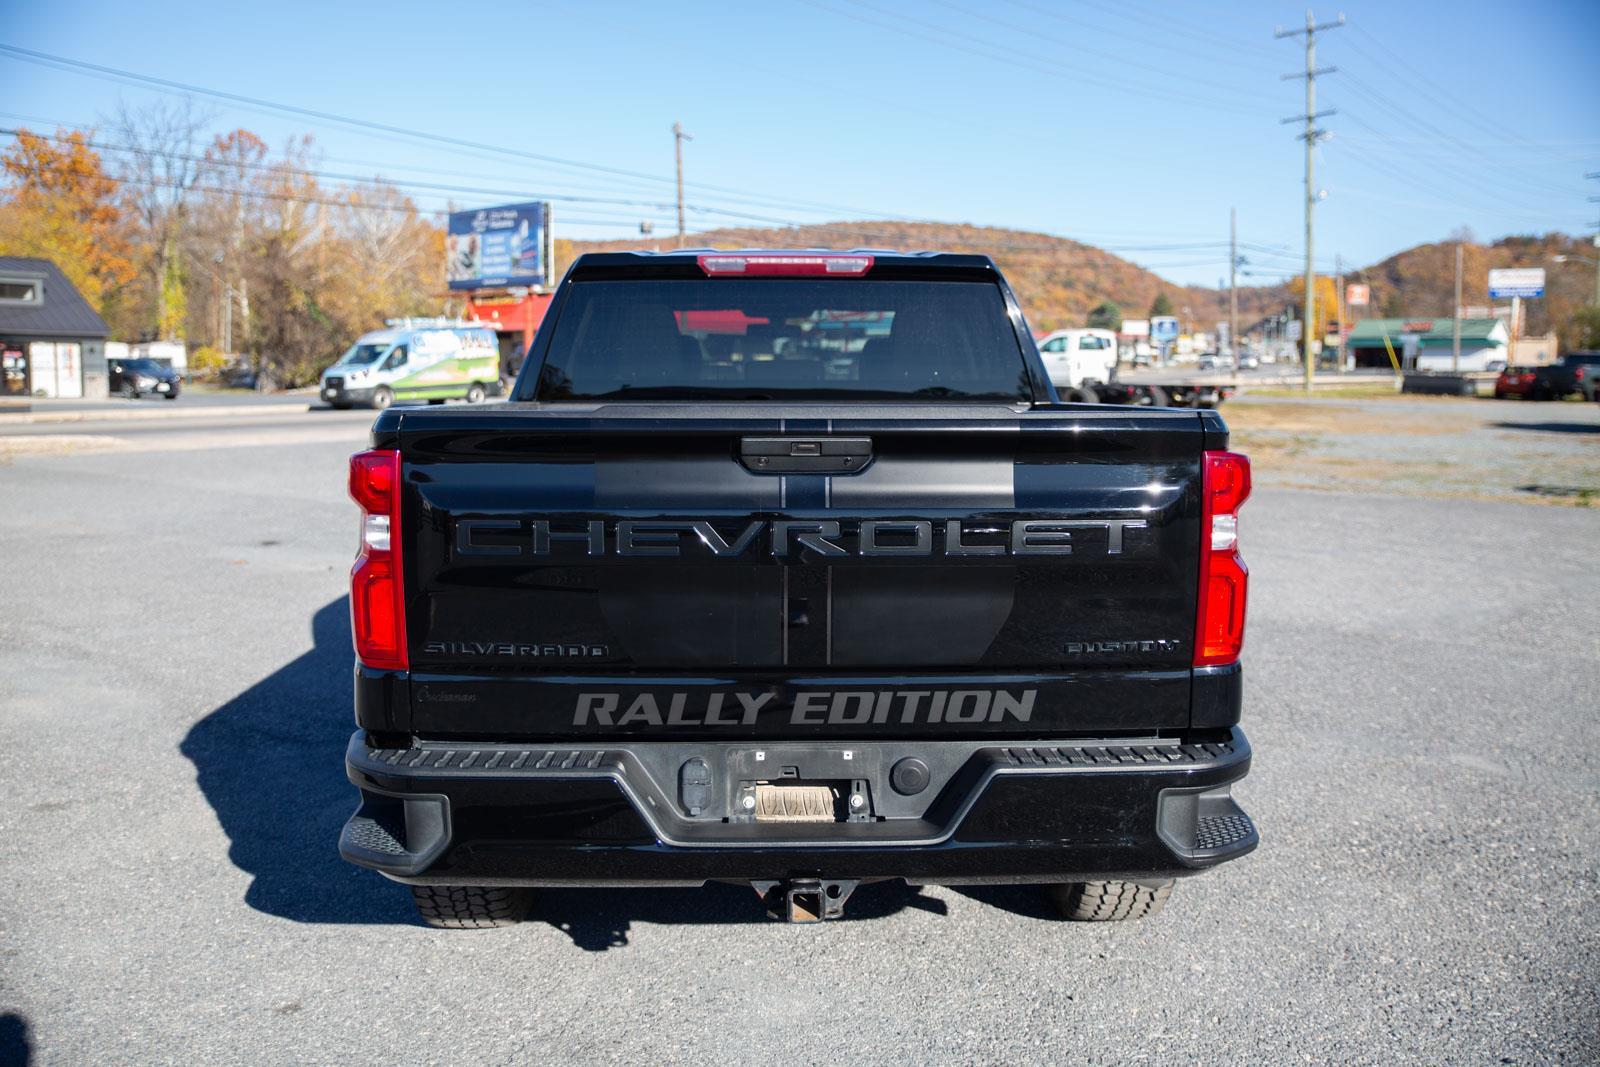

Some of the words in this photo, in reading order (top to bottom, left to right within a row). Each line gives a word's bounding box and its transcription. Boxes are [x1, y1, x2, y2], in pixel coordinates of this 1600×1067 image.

[455, 518, 1148, 558] CHEVROLET
[424, 641, 609, 657] SILVERADO
[1063, 639, 1180, 654] CUSTOM
[572, 692, 775, 726] RALLY
[789, 689, 1038, 725] EDITION
